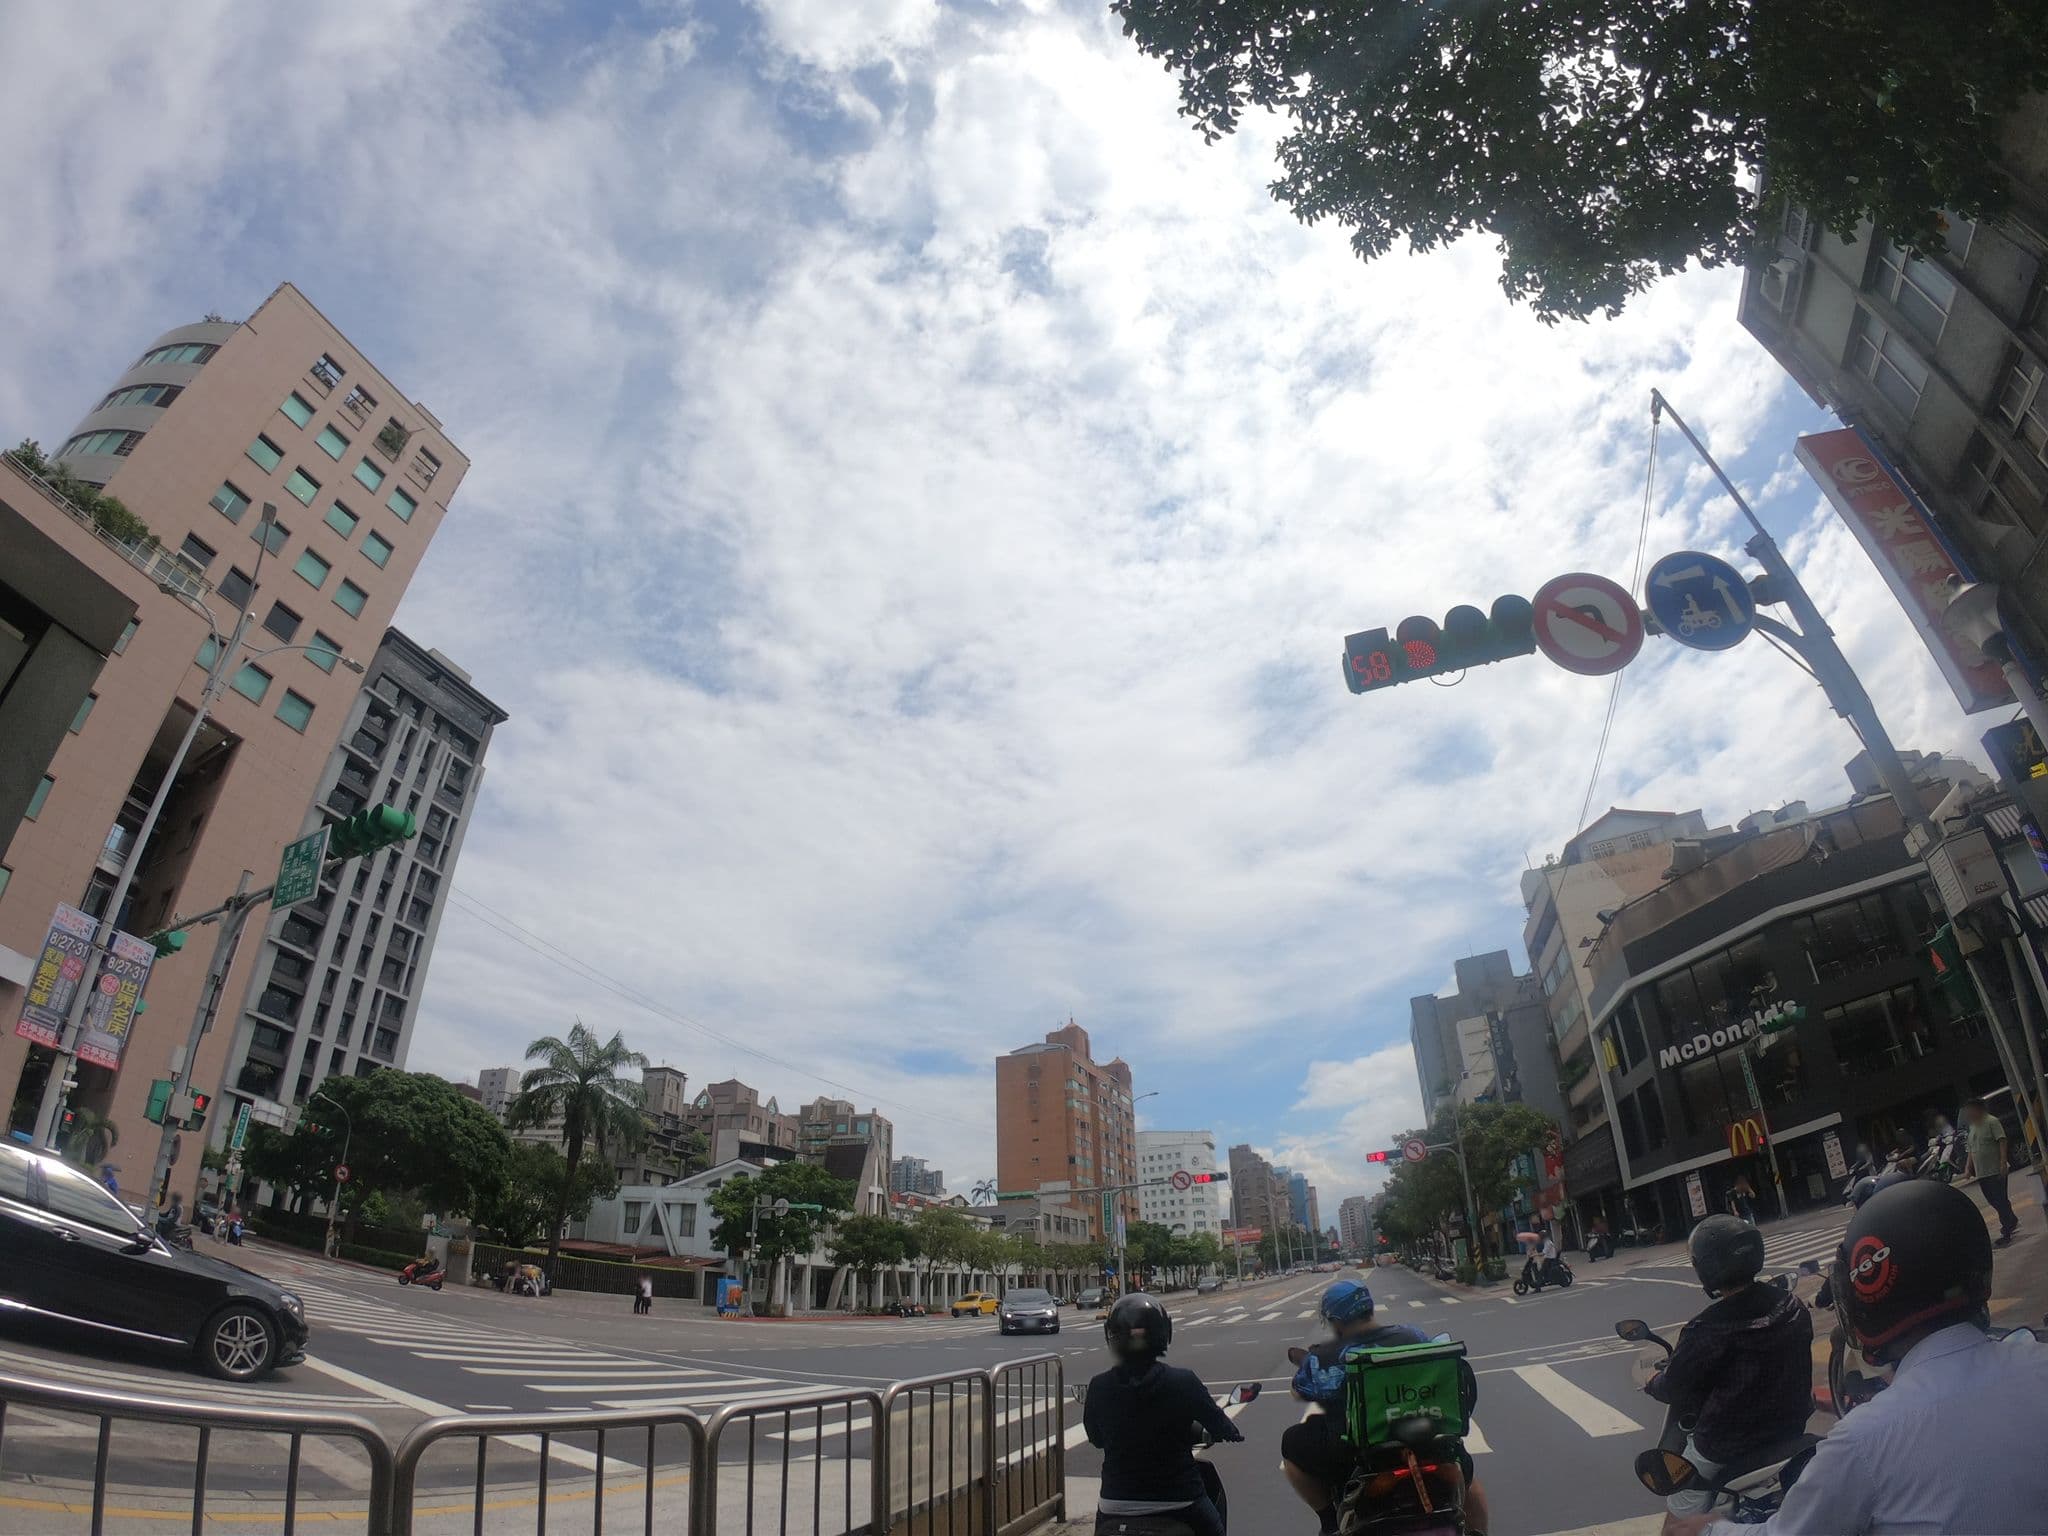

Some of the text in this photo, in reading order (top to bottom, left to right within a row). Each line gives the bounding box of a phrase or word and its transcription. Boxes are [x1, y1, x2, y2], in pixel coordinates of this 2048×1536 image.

[1351, 651, 1391, 686] 58
[105, 978, 139, 1037] 世界名床
[1659, 999, 1798, 1070] McDonald's
[1849, 1246, 1891, 1283] PGO
[1385, 1383, 1438, 1404] Uber
